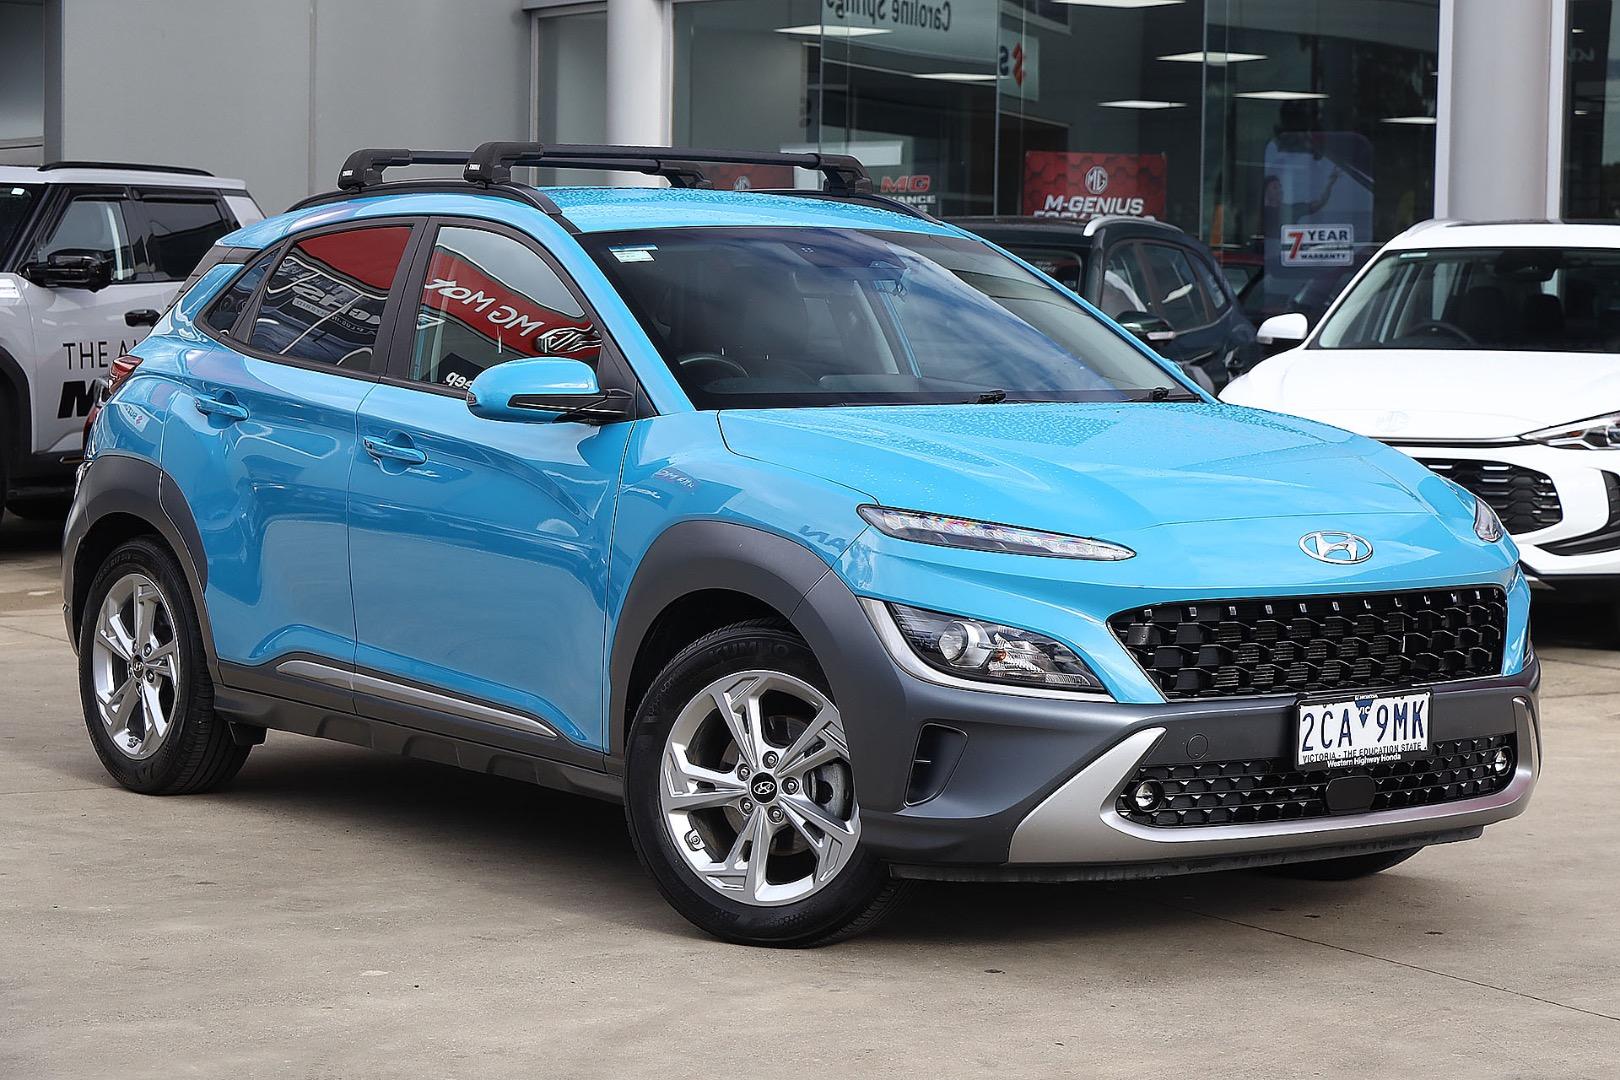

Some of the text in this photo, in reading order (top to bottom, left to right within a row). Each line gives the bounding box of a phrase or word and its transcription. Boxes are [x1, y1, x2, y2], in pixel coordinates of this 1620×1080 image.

[881, 176, 931, 192] MG
[1043, 195, 1144, 214] M-GENIUS
[1288, 232, 1304, 259] 7
[1307, 230, 1348, 241] YEAR
[63, 341, 109, 371] THE
[1302, 700, 1424, 752] 2CA 9MK
[1302, 752, 1336, 763] VICTORIA
[1343, 748, 1357, 758] THE
[1359, 744, 1399, 757] EDUCATION
[1400, 742, 1421, 752] STATE
[1327, 752, 1402, 769] Western Highway Honda
